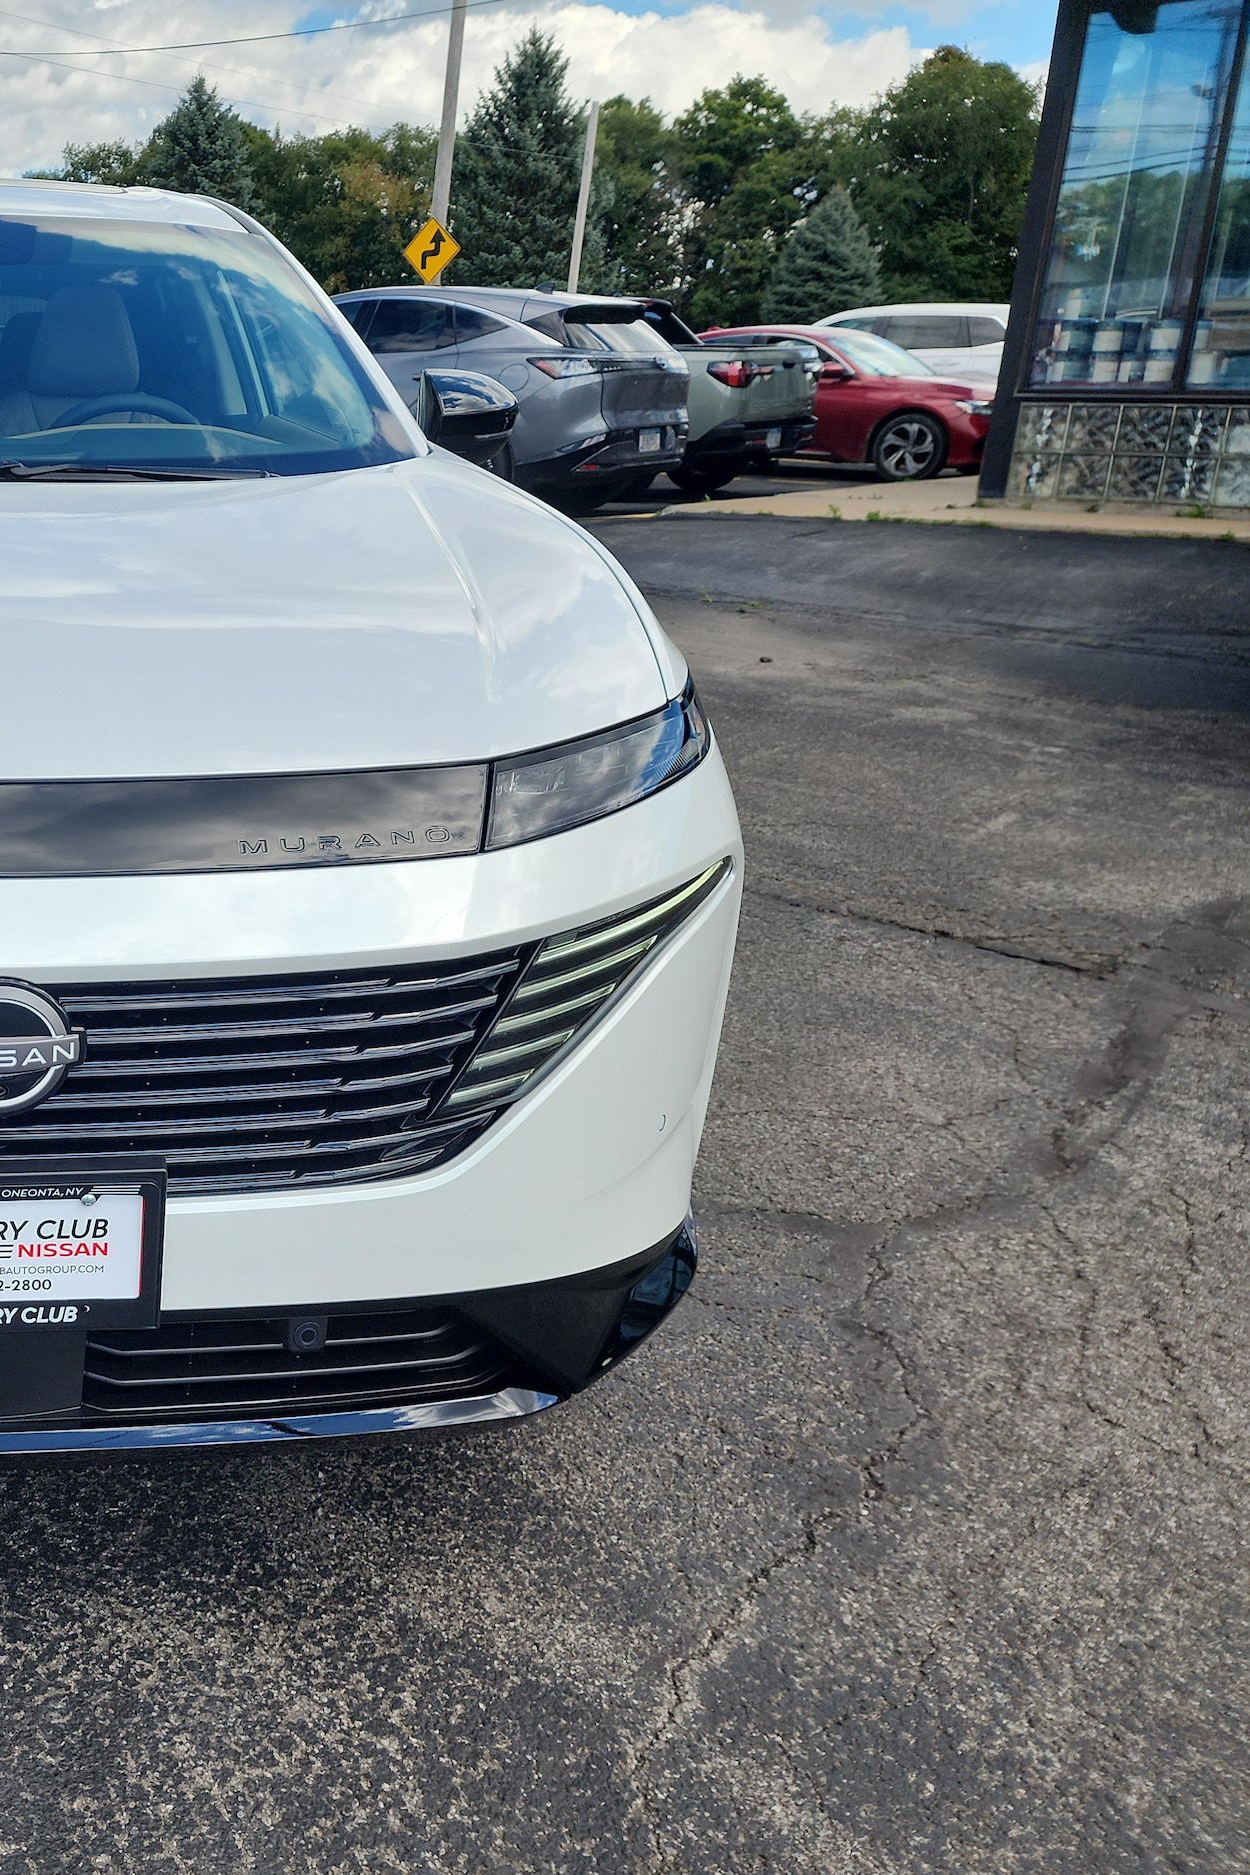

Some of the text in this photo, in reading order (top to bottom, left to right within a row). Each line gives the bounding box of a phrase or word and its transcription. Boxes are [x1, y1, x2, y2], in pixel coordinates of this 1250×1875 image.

[239, 825, 451, 854] MURANO
[36, 1218, 109, 1240] CLUB
[17, 1242, 109, 1258] NISSAN
[20, 1305, 78, 1324] CLUB
